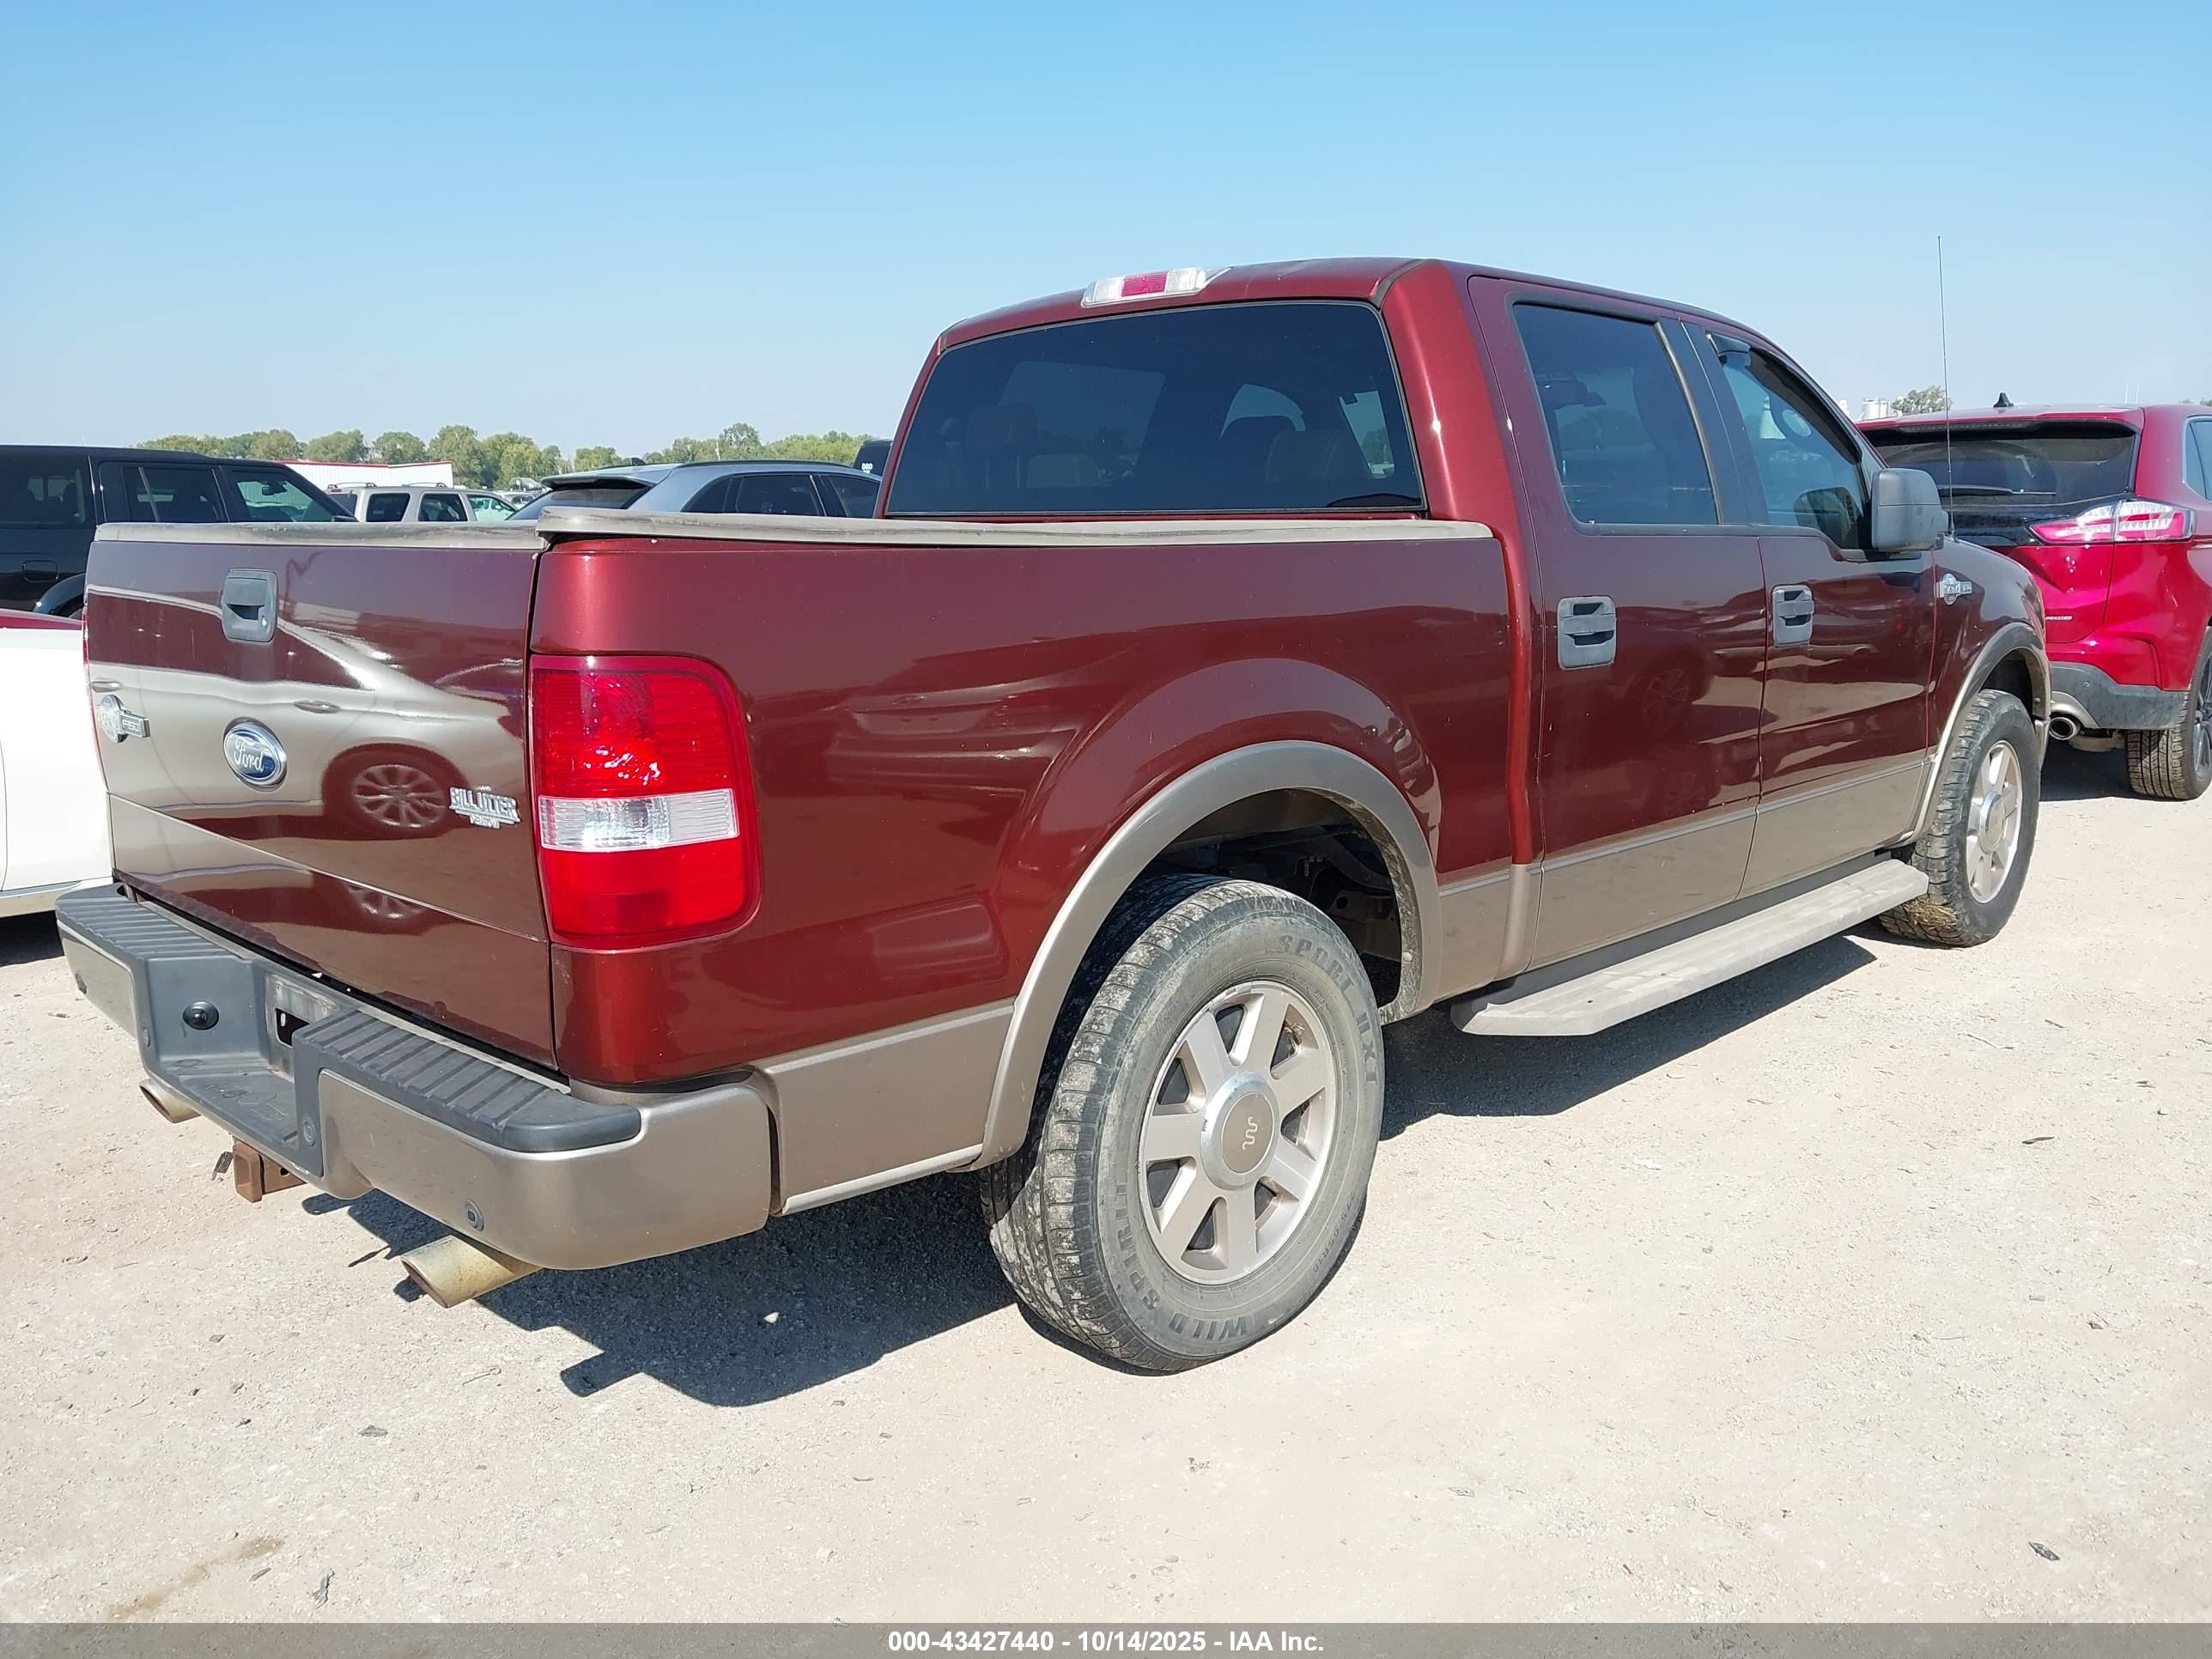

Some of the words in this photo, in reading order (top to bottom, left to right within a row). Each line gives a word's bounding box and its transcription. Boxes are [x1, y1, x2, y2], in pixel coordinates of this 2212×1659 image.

[233, 736, 265, 773] Ford
[449, 786, 480, 811] BILL
[476, 791, 519, 819] UTTER
[1276, 933, 1356, 994] SPORT
[1115, 1182, 1161, 1312] SPIRIT
[1168, 1311, 1249, 1342] WILD
